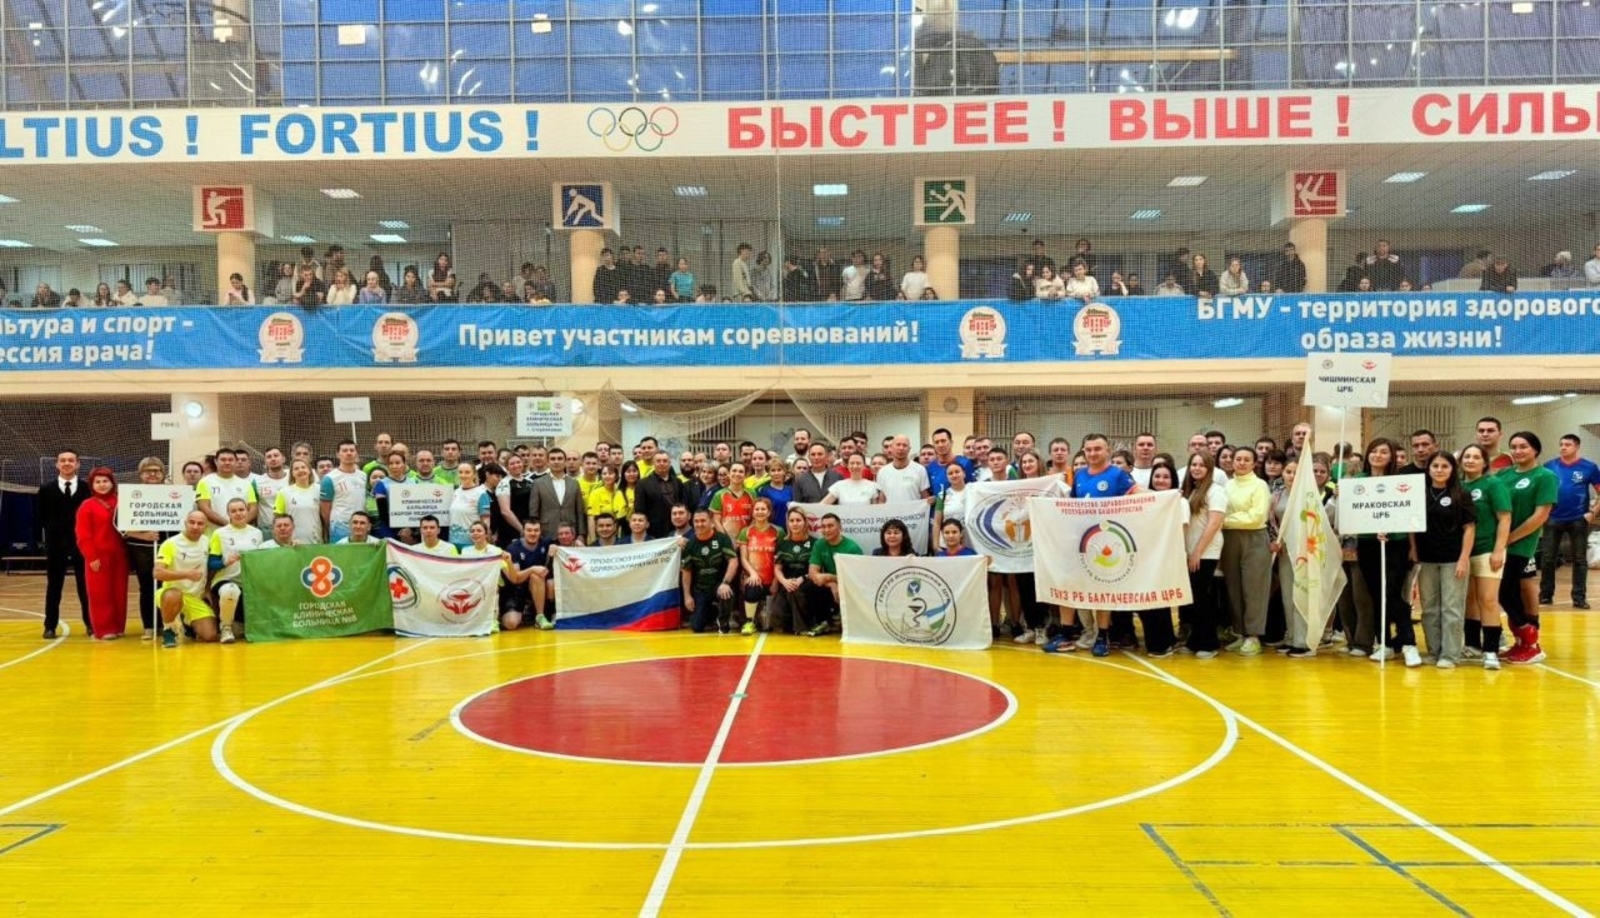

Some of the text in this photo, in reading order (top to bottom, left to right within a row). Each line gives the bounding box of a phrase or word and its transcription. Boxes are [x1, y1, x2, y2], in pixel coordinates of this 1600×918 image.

[727, 102, 1029, 149] БЫСТРЕЕ
[1109, 96, 1313, 141] ВЫШЕ
[1412, 92, 1600, 136] СИЛЬ
[240, 111, 503, 155] FORTIUS
[1197, 297, 1273, 321] БГМУ
[1298, 298, 1457, 326] территория
[1464, 297, 1600, 321] здорового
[81, 317, 97, 334] и
[103, 315, 177, 337] спорт
[459, 320, 919, 351] Привет участникам соревнований!
[1301, 326, 1503, 352] образа жизни!
[69, 339, 155, 367] врача!
[1318, 375, 1376, 384] ЧИШМИНСКАЯ
[1336, 385, 1354, 393] ЦРБ
[1100, 496, 1156, 508] ЗДРАВООХРАНЕНИЯ
[1351, 500, 1411, 510] МРАКОВСКАЯ
[132, 510, 179, 518] БОЛЬНИЦА
[1098, 506, 1143, 515] БАШКОРТОСТАН
[1372, 511, 1391, 519] ЦРБ
[712, 540, 719, 549] 5
[1050, 587, 1184, 604] ГБУЗ РБ БАЛТАЧЕВСКАЯ ЦРБ
[299, 600, 346, 610] ГОРОДСКАЯ
[293, 607, 354, 620] КЛИНИЧЕСКАЯ
[292, 617, 340, 628] БОЛЬНИЦА
